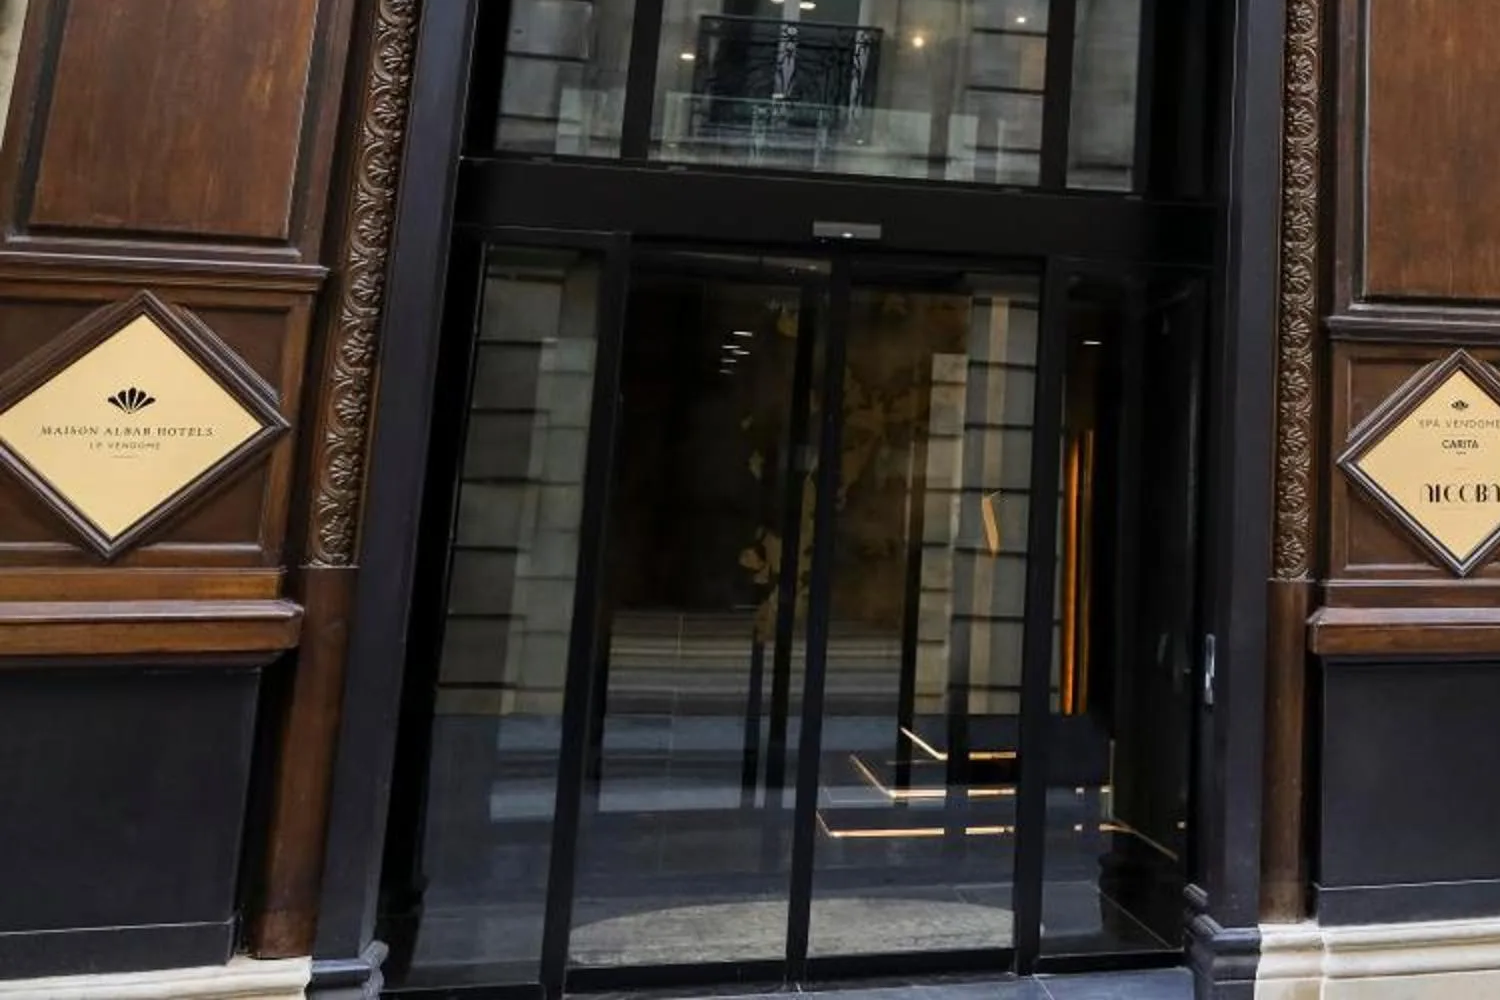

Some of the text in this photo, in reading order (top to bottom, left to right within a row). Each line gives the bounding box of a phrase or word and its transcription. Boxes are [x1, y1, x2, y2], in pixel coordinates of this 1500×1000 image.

[1418, 418, 1441, 430] SPA
[39, 424, 99, 437] MAISON
[157, 426, 214, 438] HOTELS
[1441, 439, 1480, 449] CARITA
